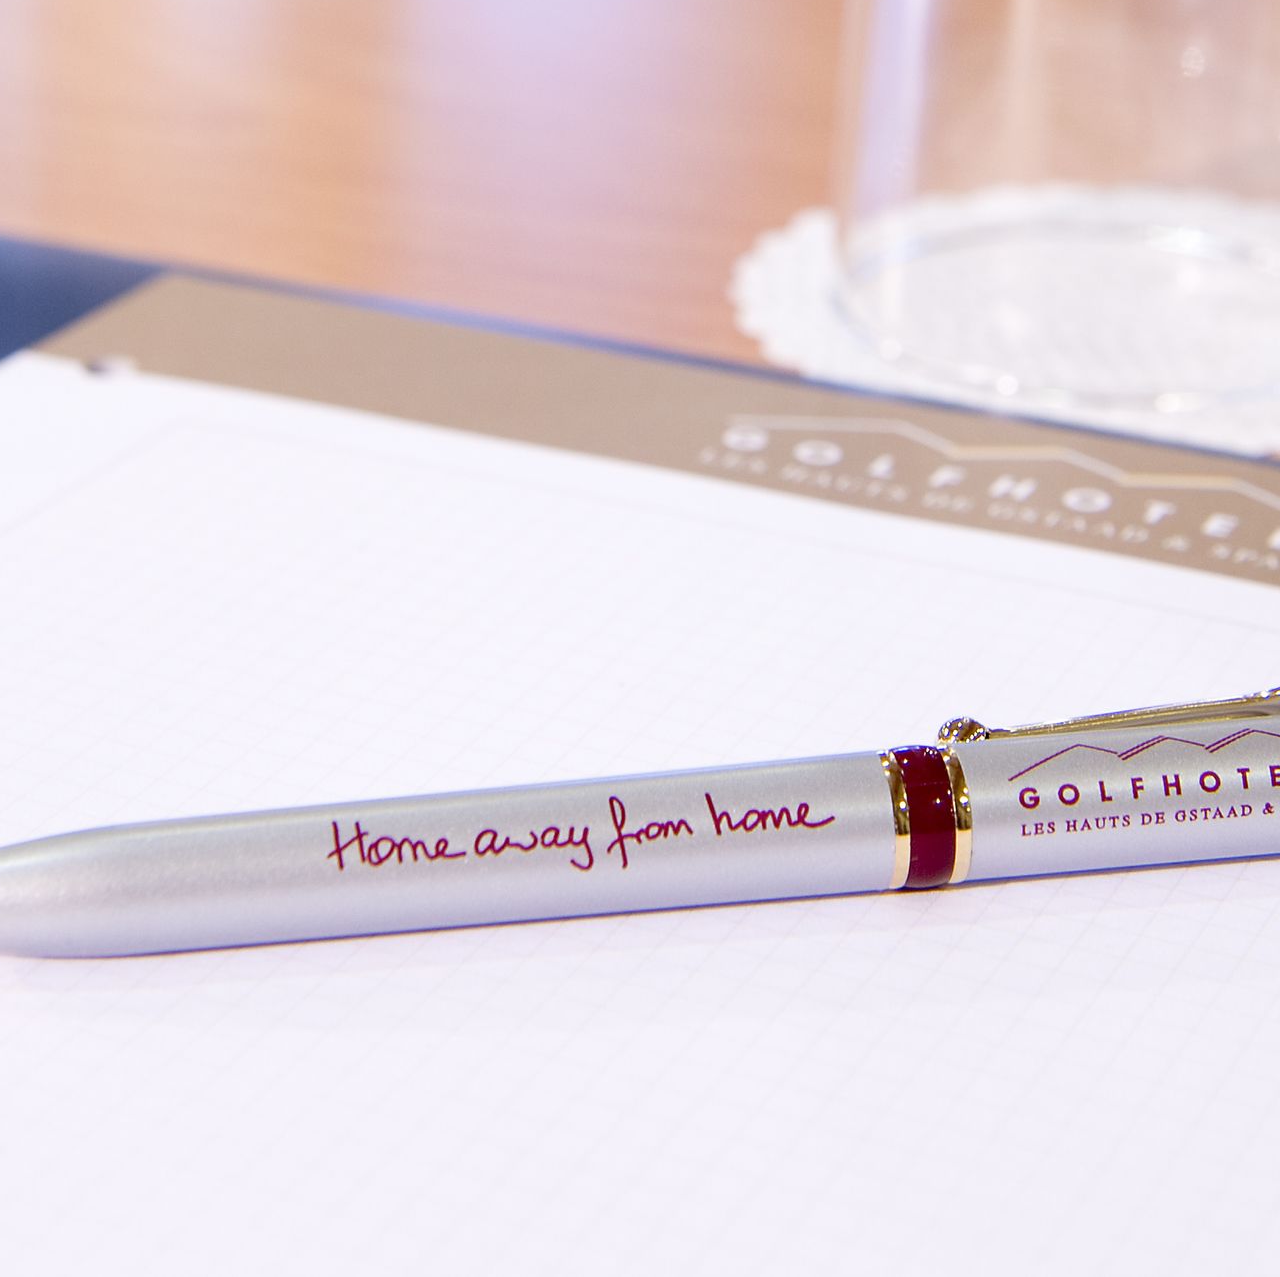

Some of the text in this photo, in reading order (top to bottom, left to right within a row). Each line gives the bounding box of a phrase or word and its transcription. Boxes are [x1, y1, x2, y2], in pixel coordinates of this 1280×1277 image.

[327, 791, 836, 872] Home away from home
[1021, 821, 1057, 837] LES
[1065, 814, 1132, 833] HAUTS
[1140, 811, 1166, 826] DE
[1174, 804, 1254, 823] GSTAAD
[1262, 802, 1275, 816] &
